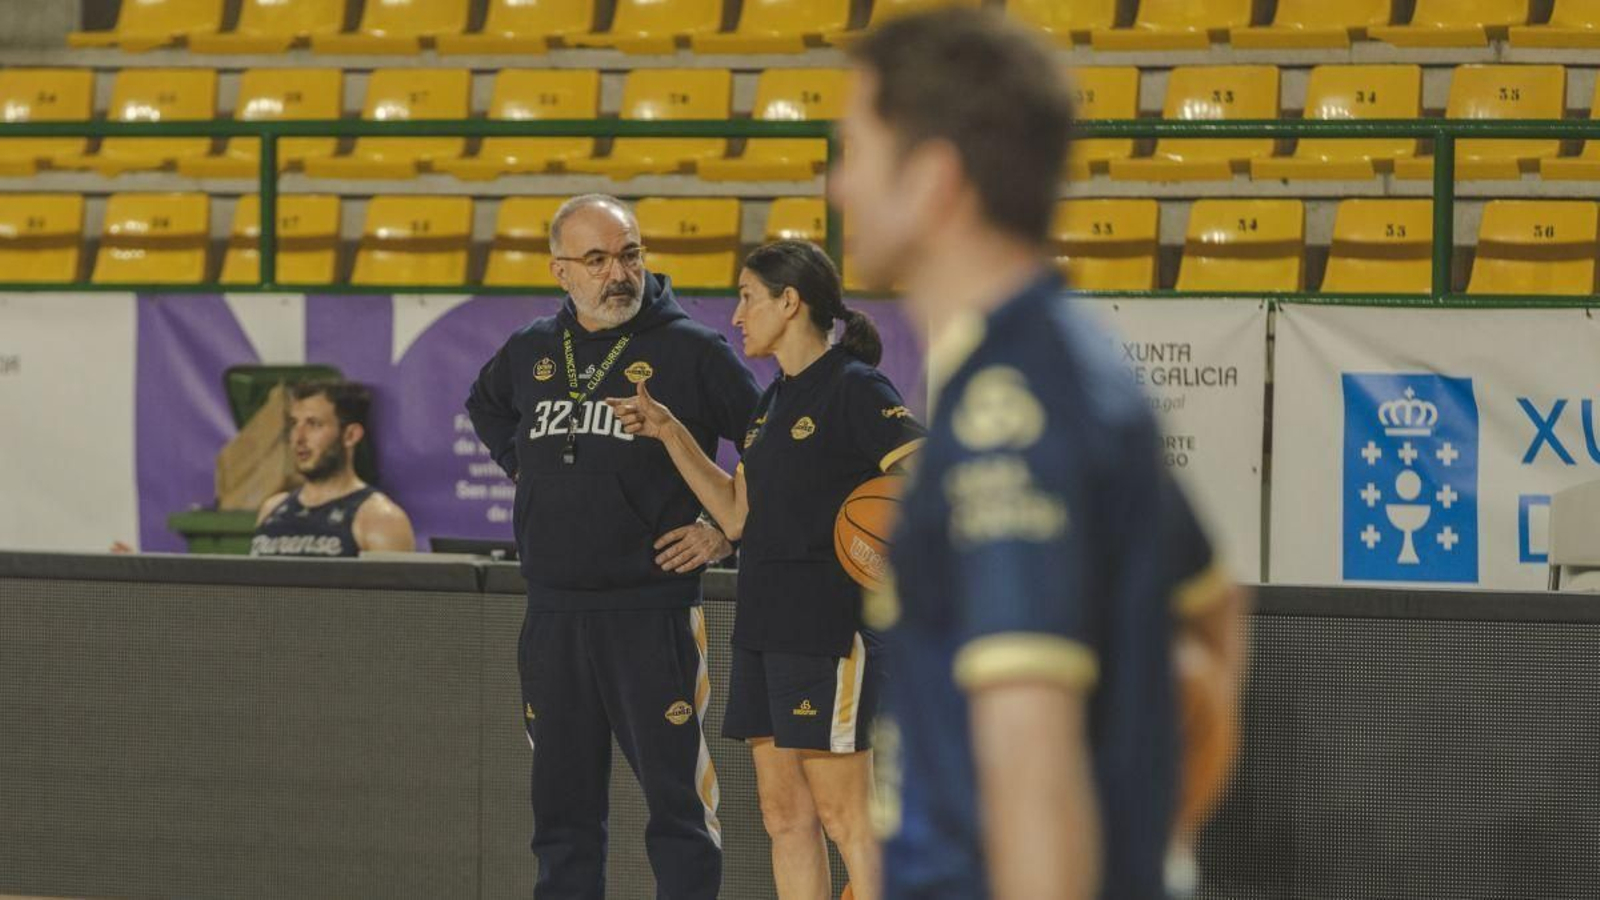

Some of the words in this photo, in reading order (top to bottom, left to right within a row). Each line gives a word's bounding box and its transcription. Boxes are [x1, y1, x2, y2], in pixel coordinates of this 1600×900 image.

[587, 369, 605, 390] CLUB
[600, 336, 630, 371] OURENSE
[1122, 342, 1192, 363] XUNTA
[1151, 366, 1238, 388] GALICIA
